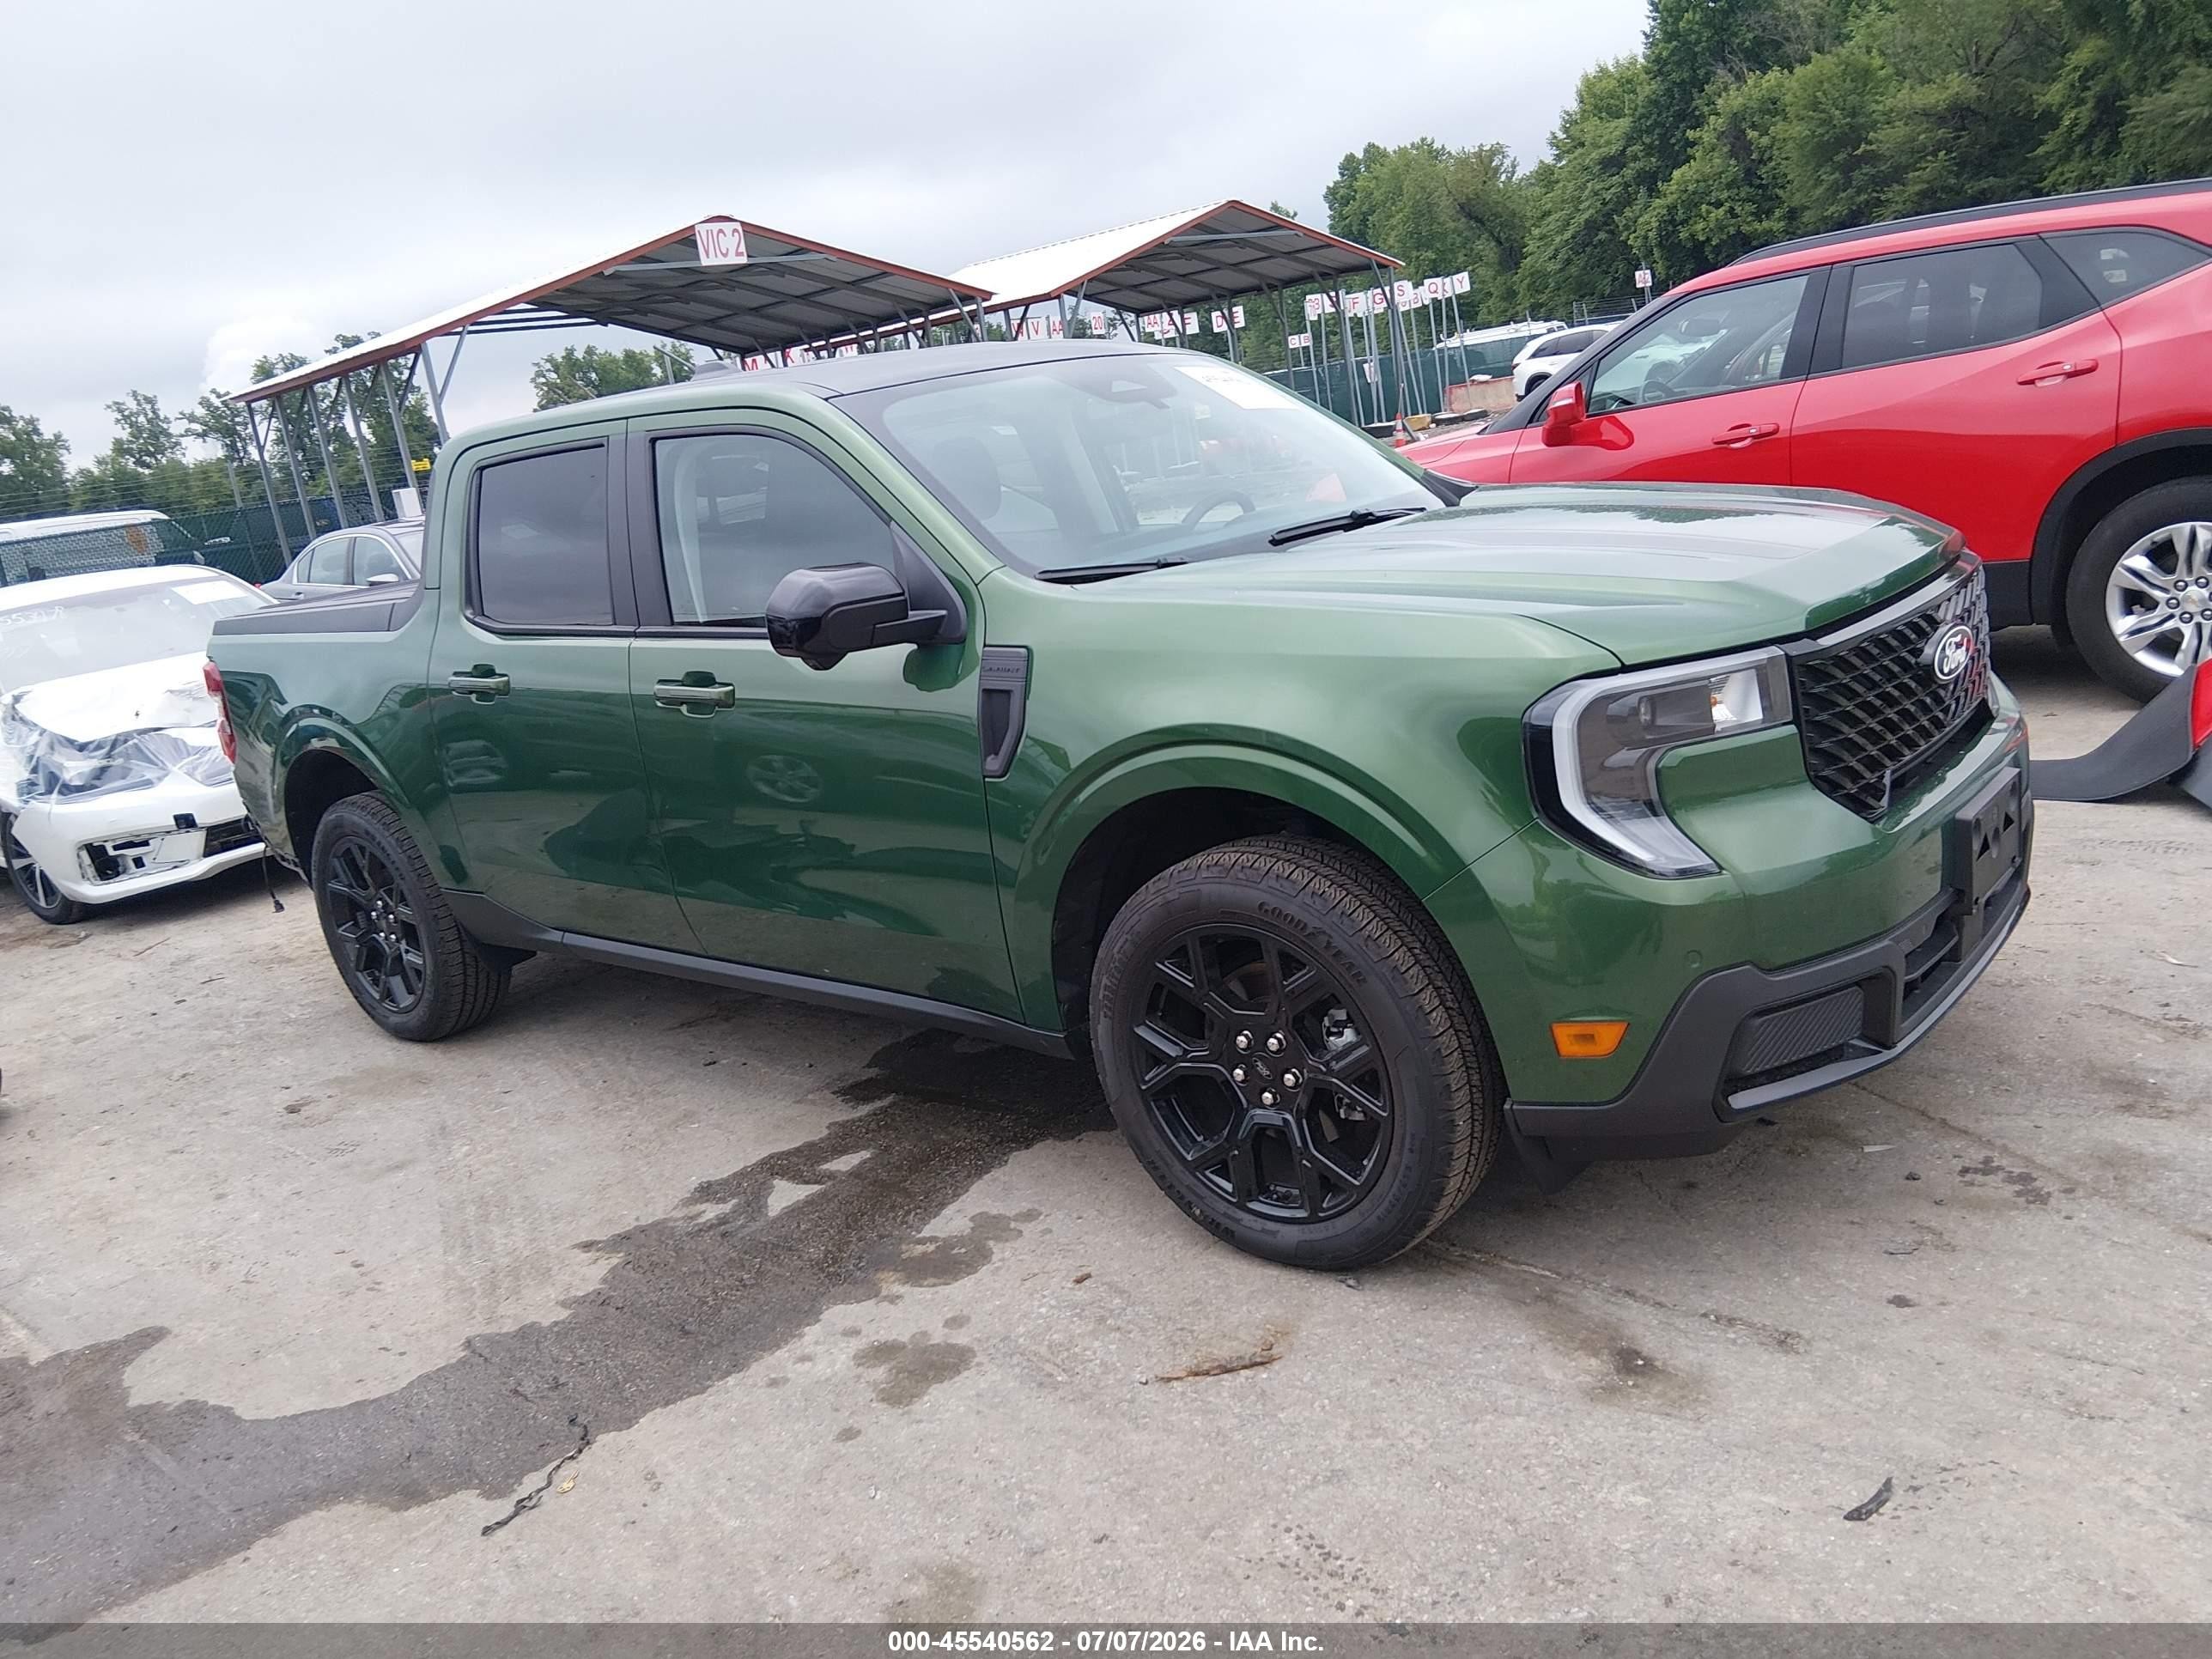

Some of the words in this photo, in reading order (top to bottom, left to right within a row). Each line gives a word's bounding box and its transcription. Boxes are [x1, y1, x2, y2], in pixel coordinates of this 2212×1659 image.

[697, 228, 729, 258] VIC
[732, 228, 744, 257] 2
[1428, 282, 1439, 295] Q
[1456, 276, 1465, 289] Y
[1397, 284, 1406, 297] S
[1351, 296, 1359, 310] F
[1373, 293, 1384, 305] G
[1031, 320, 1040, 336] V
[1092, 315, 1103, 330] 20
